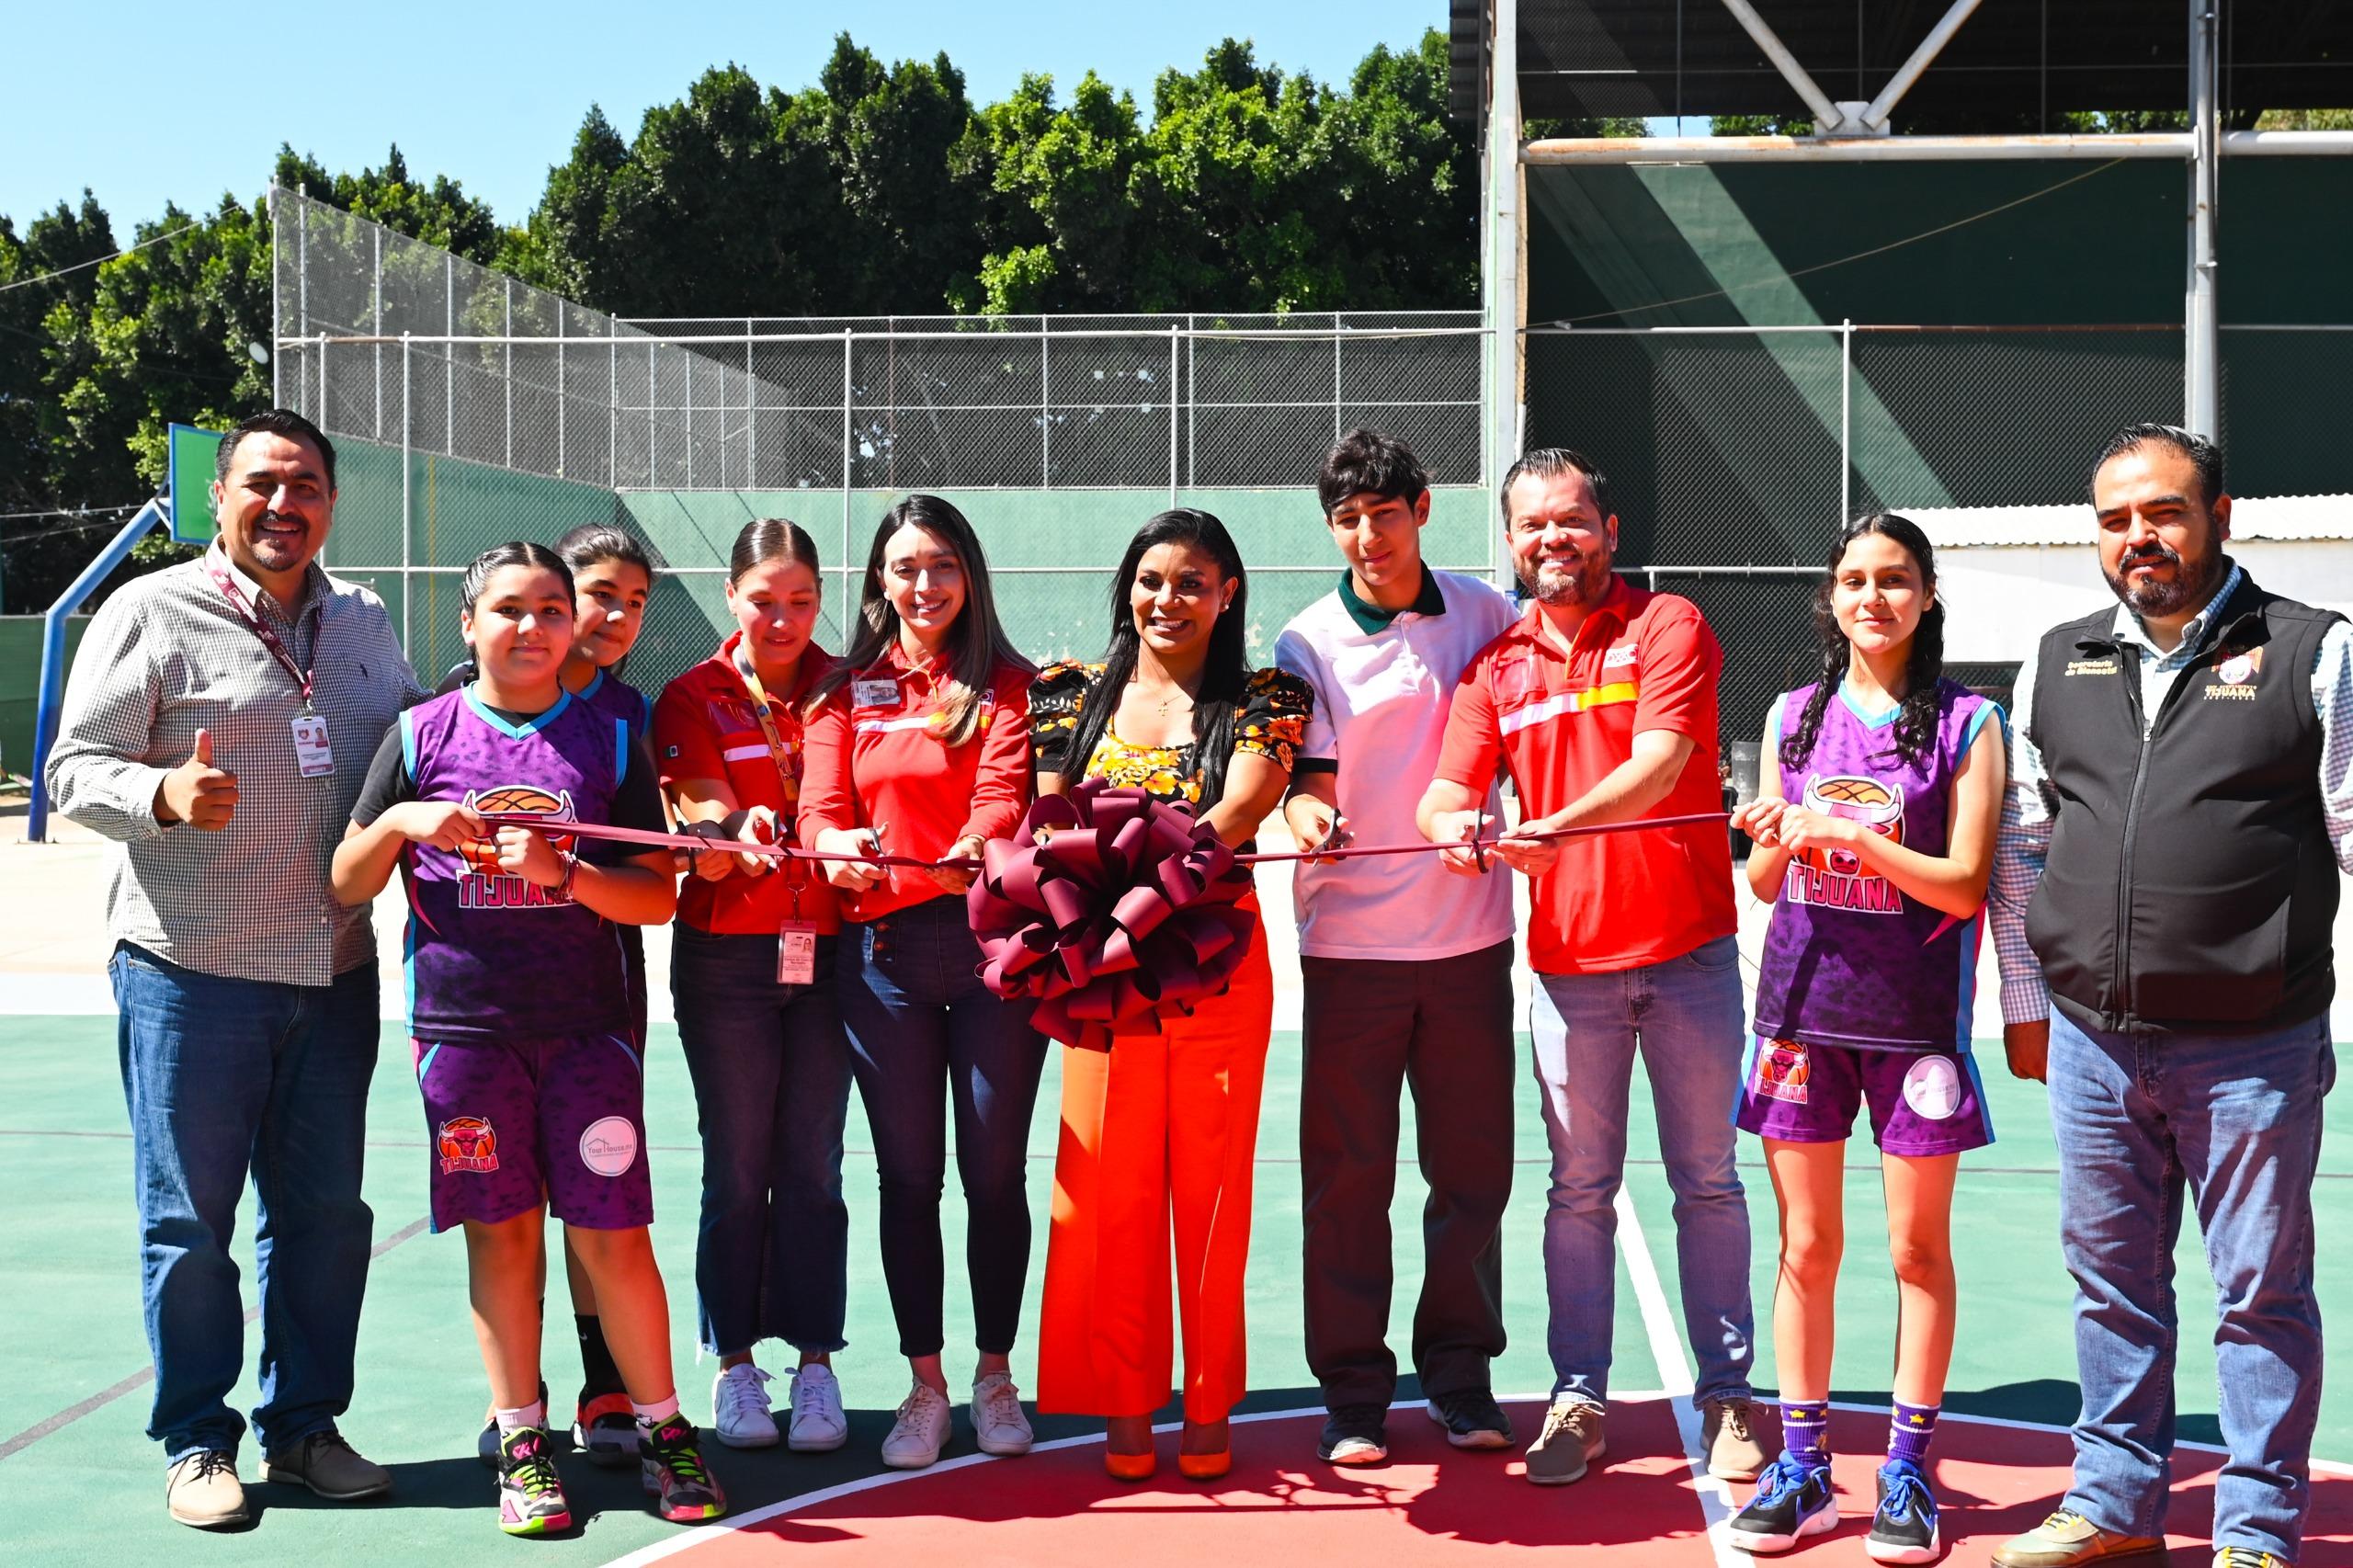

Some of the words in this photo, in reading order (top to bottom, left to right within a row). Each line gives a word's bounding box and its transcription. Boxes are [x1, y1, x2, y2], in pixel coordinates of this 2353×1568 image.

[2205, 687, 2256, 698] TIJUANA
[1787, 861, 1904, 912] TIJUANA
[440, 1153, 499, 1176] TIJUANA
